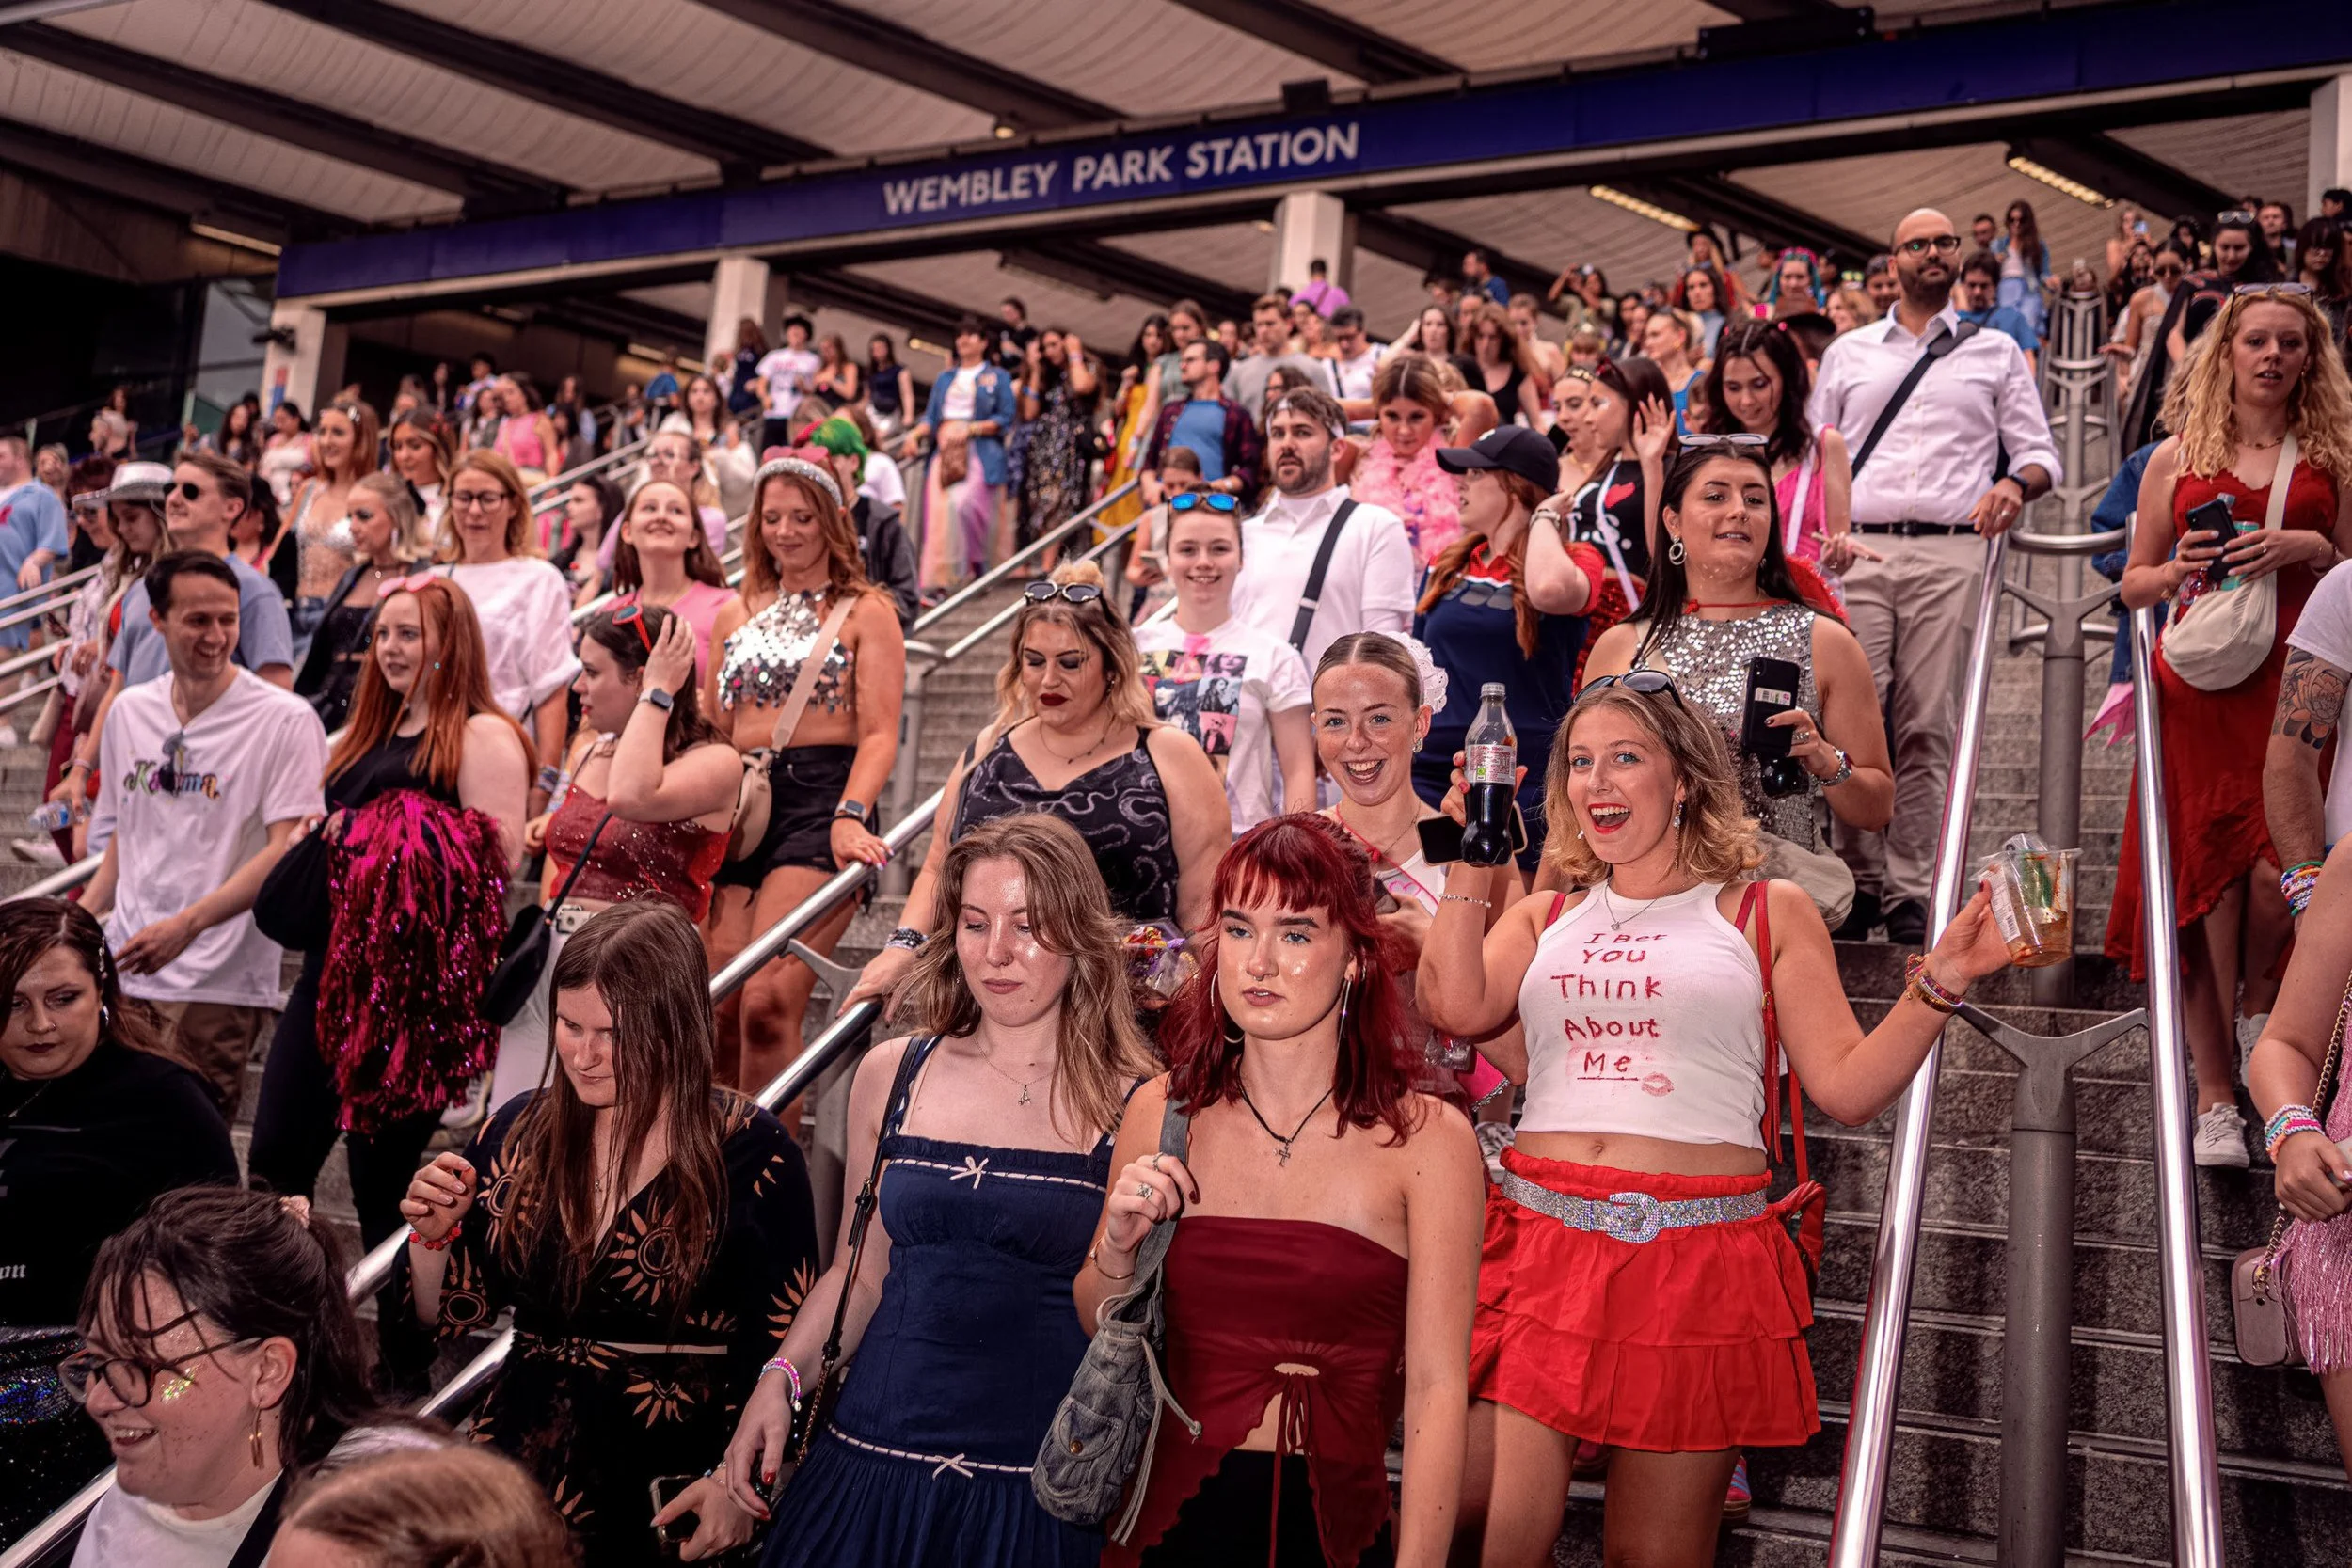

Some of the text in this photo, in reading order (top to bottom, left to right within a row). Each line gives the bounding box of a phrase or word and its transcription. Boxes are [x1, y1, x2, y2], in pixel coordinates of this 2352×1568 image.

[882, 122, 1360, 215] WEMBLEY PARK STATION
[123, 759, 221, 799] Kama
[1583, 933, 1668, 944] I Bet
[1550, 974, 1663, 1000] Think
[1564, 1016, 1661, 1041] About
[1583, 1051, 1632, 1073] Me
